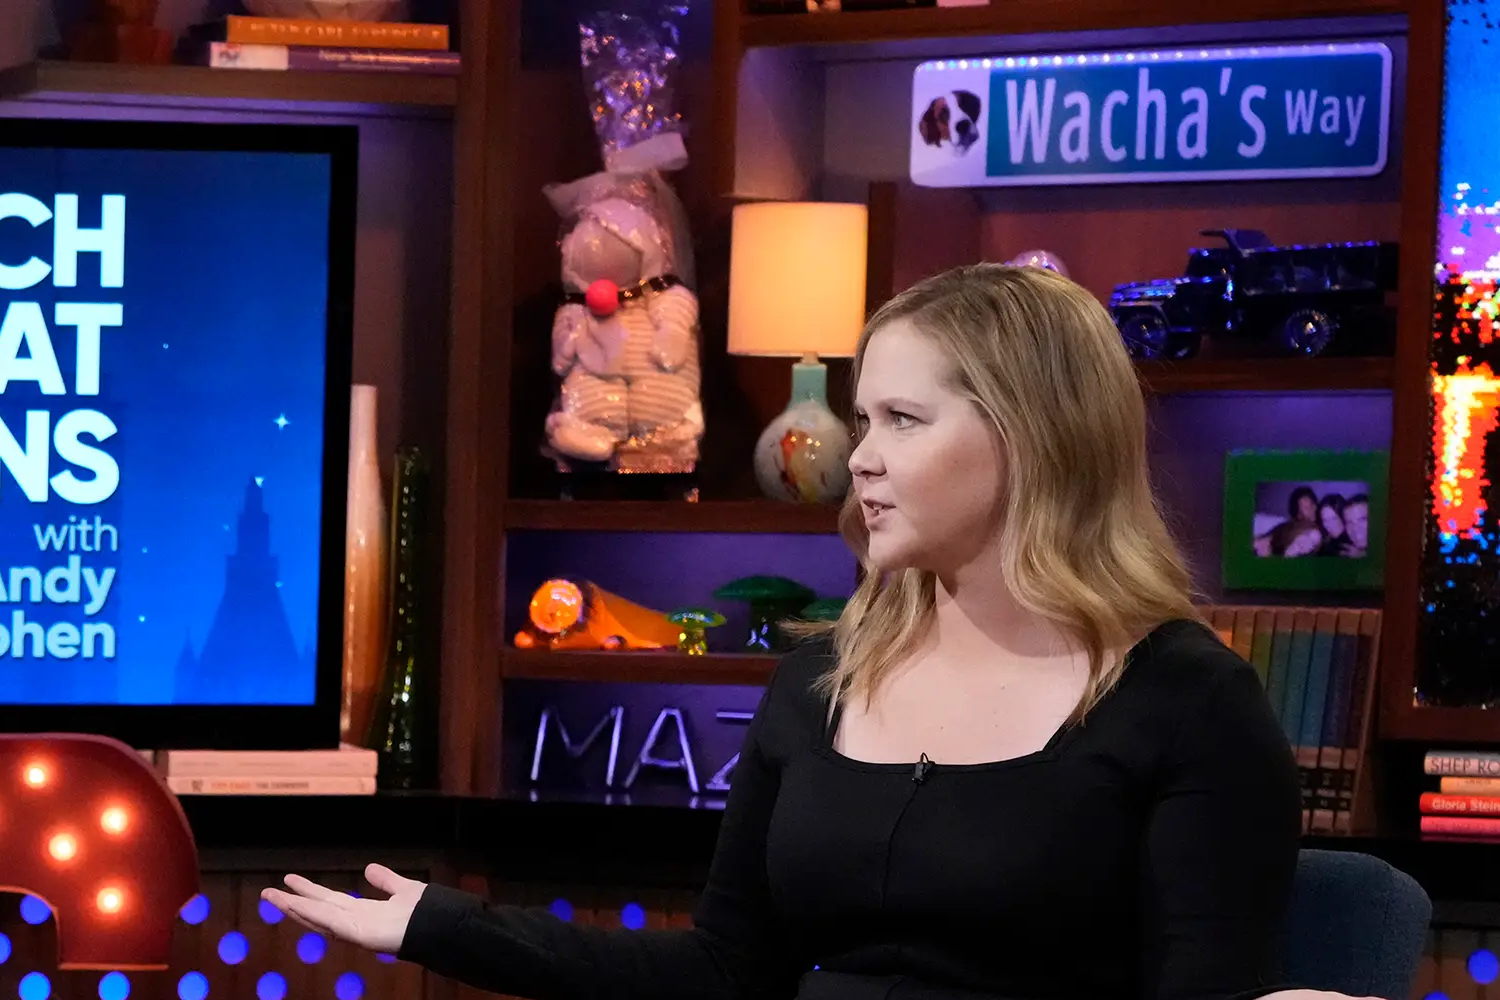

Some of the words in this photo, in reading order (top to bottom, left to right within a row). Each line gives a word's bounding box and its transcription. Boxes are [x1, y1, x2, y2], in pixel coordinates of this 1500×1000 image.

[1006, 67, 1267, 164] Wacha's
[1285, 89, 1366, 147] Way
[33, 515, 118, 551] with
[1431, 757, 1471, 774] SHEP
[1432, 798, 1467, 811] Gloria
